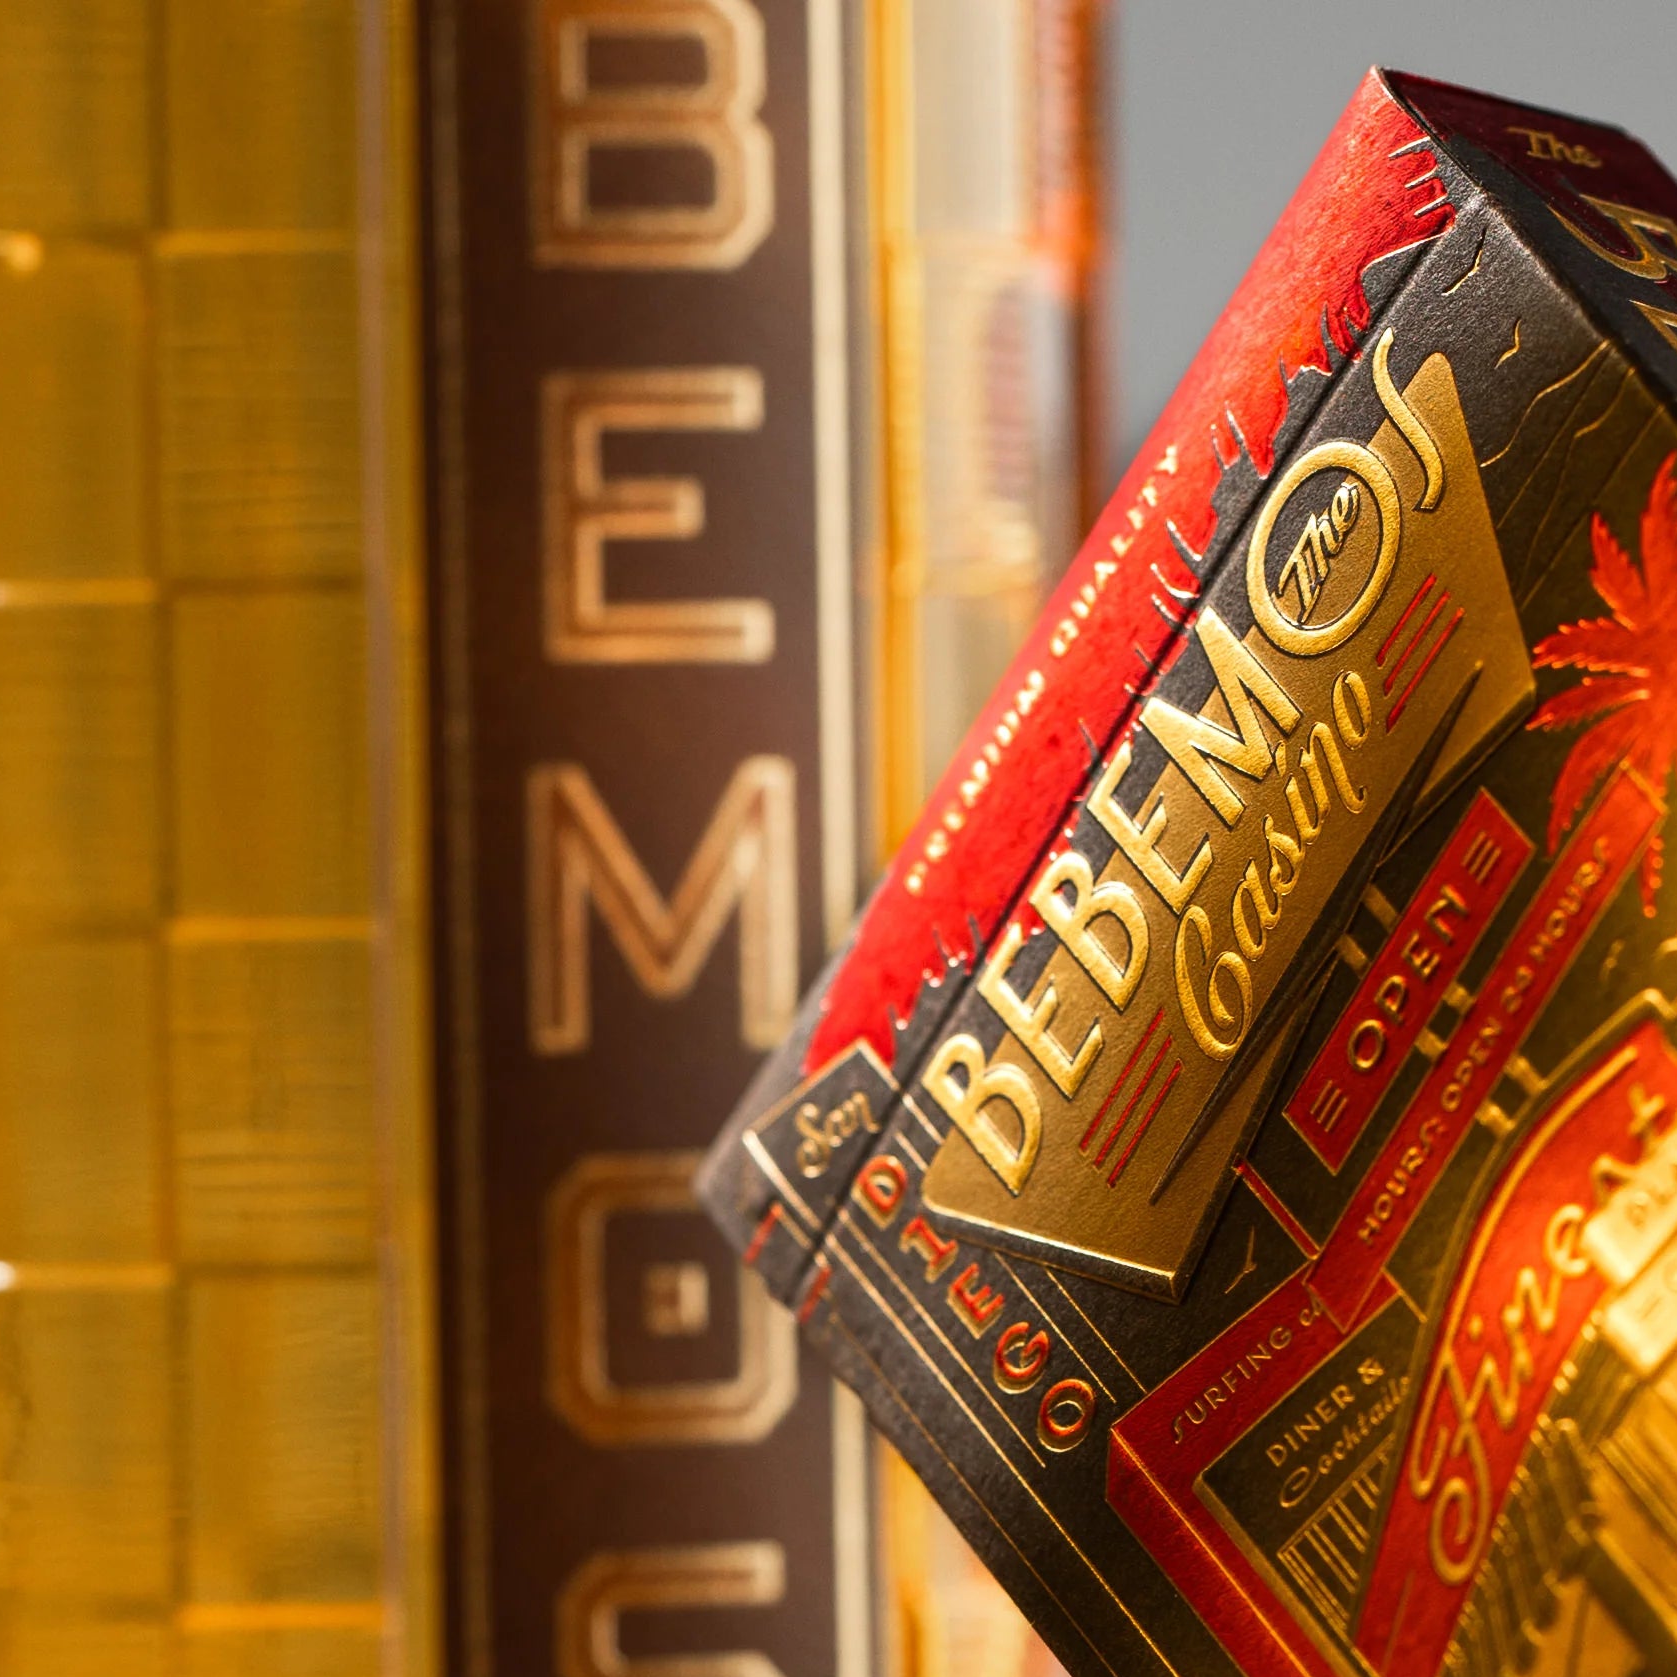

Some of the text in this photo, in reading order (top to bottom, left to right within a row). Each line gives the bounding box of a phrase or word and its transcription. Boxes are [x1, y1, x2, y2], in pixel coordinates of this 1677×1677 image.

[1507, 127, 1603, 168] The
[1050, 444, 1179, 658] QUALITY
[1276, 481, 1362, 625] The
[922, 328, 1444, 1197] BEBEMOS
[1173, 670, 1373, 1062] Casino
[1347, 885, 1470, 1074] OPEN
[1441, 1019, 1504, 1110] OPEN
[1530, 834, 1611, 969] HOURS
[795, 1090, 879, 1180] San
[853, 1155, 1096, 1453] DIEGO
[1170, 1324, 1292, 1444] SURFING
[1266, 1356, 1385, 1468] DINER &
